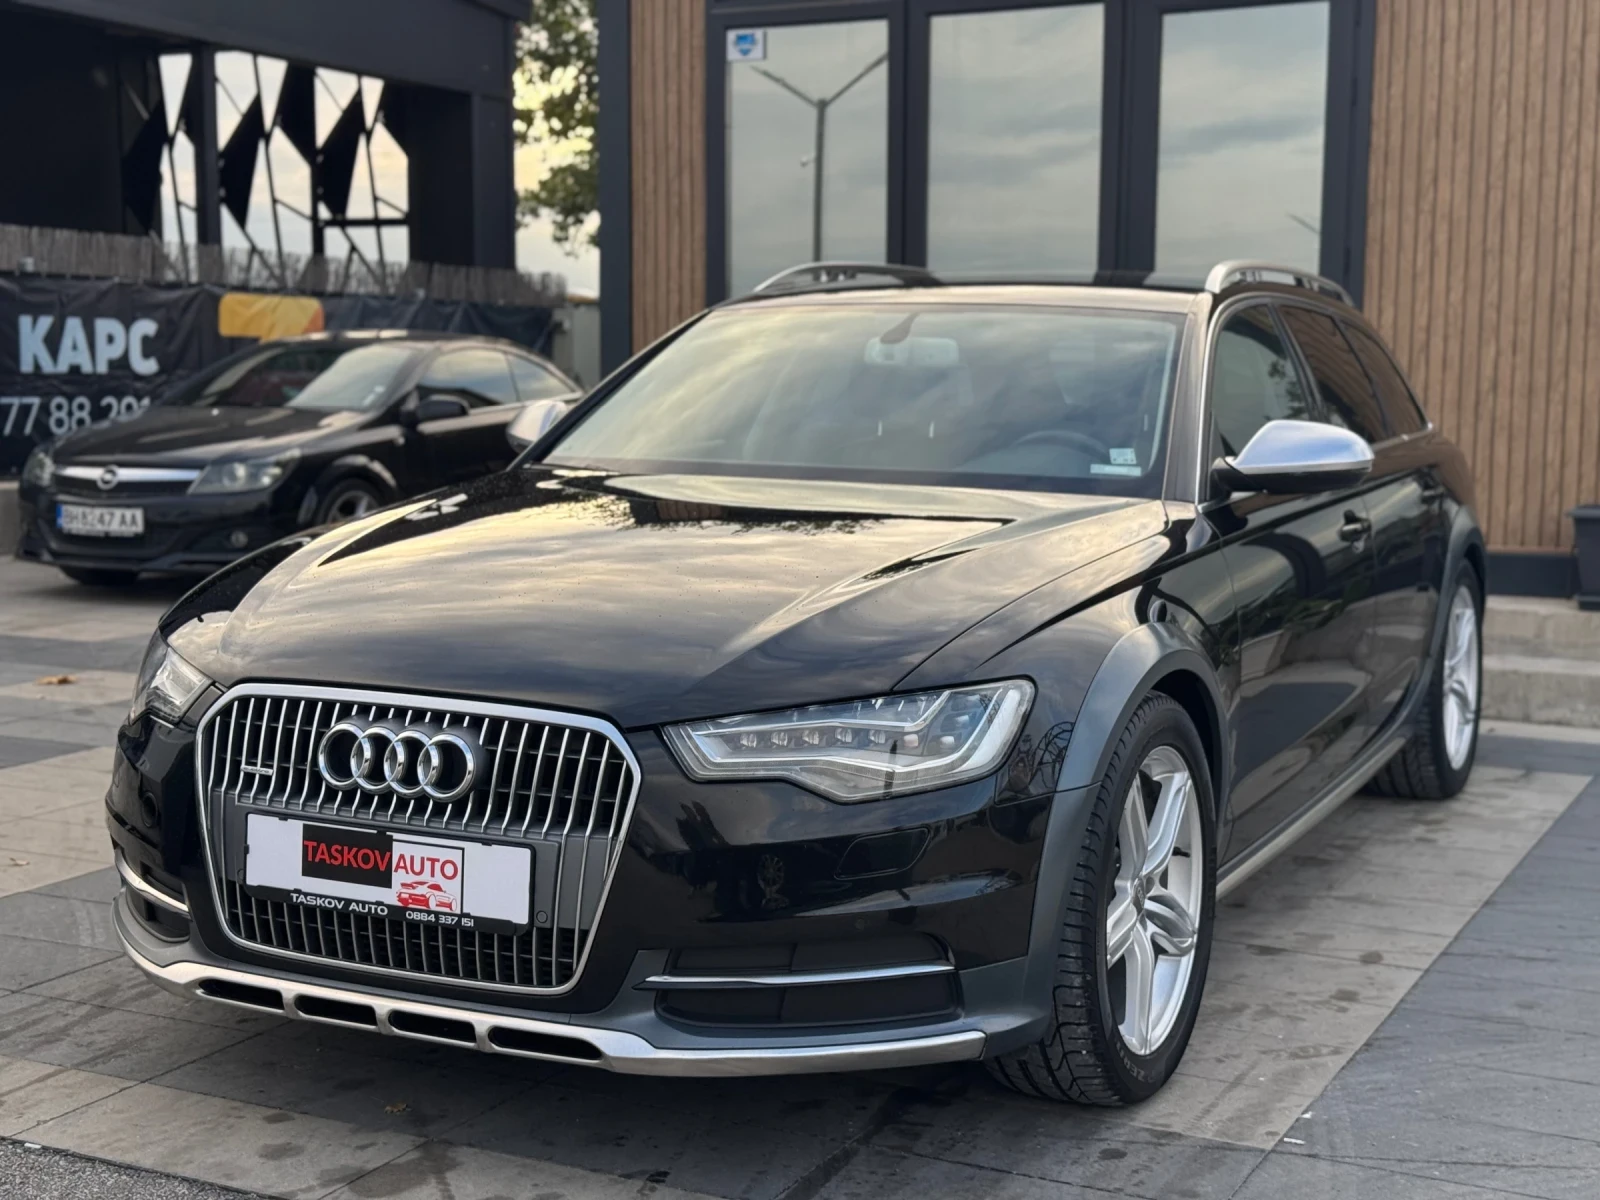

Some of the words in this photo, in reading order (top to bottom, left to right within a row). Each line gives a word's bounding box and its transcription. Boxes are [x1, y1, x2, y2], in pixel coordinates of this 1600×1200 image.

[49, 396, 91, 435] 88
[303, 840, 391, 872] TASKOV
[394, 853, 459, 880] AUTO
[290, 892, 345, 910] TASKOV
[348, 902, 388, 916] AUTO
[405, 910, 436, 923] 0884
[438, 914, 459, 926] 337
